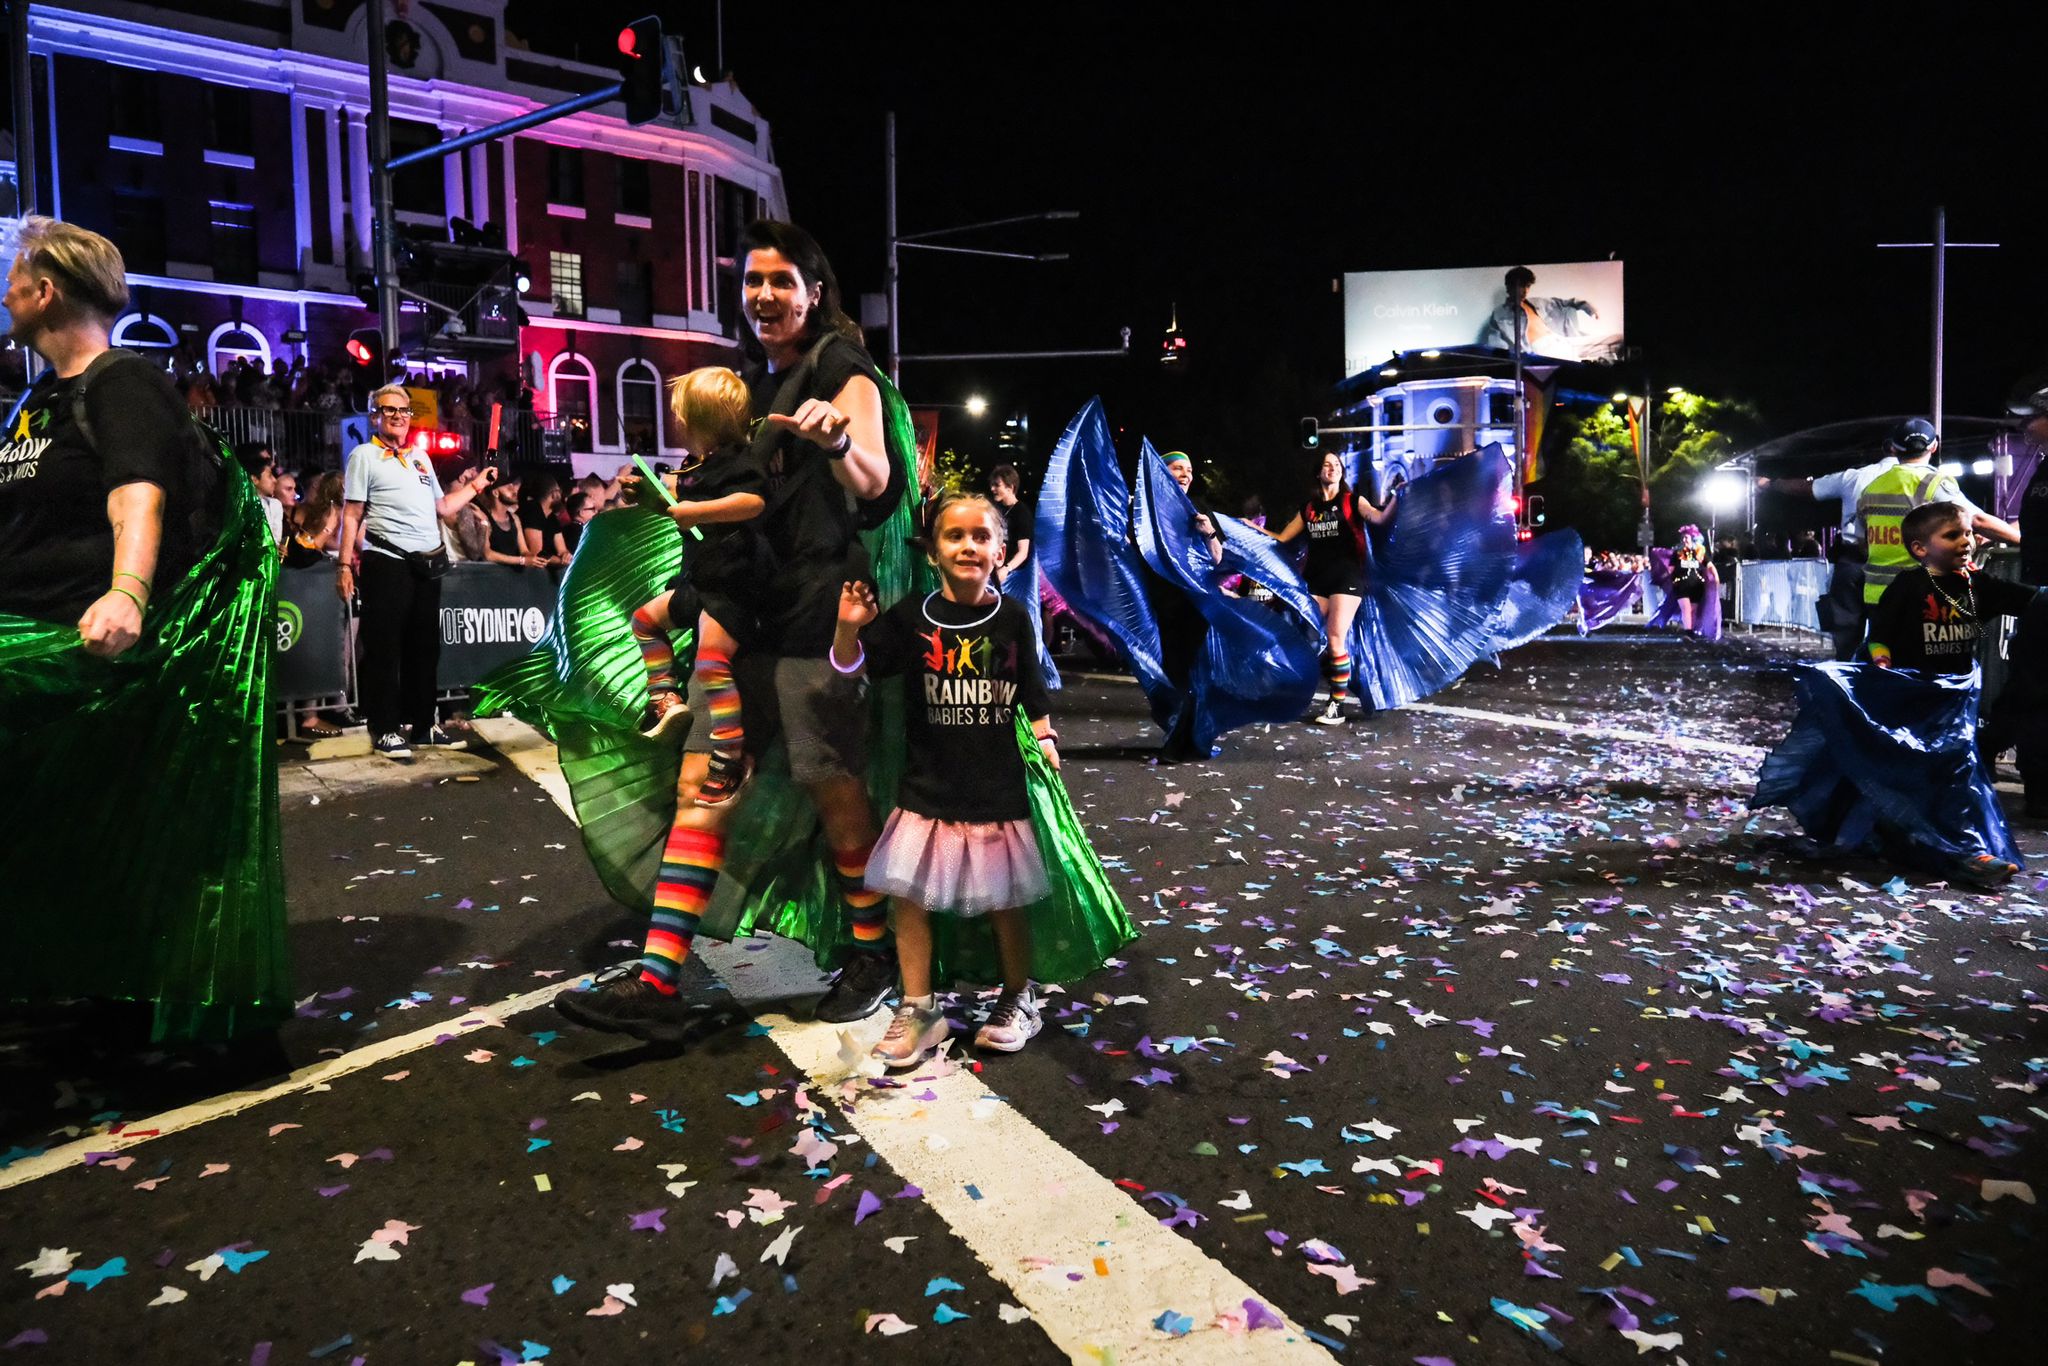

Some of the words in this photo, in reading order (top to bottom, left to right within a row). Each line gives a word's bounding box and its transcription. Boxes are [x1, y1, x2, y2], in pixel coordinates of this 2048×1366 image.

[1373, 304, 1420, 318] Calvin
[1423, 303, 1458, 316] Klein
[1867, 526, 1904, 545] OLIC
[928, 707, 975, 726] BABIES
[978, 707, 990, 725] &
